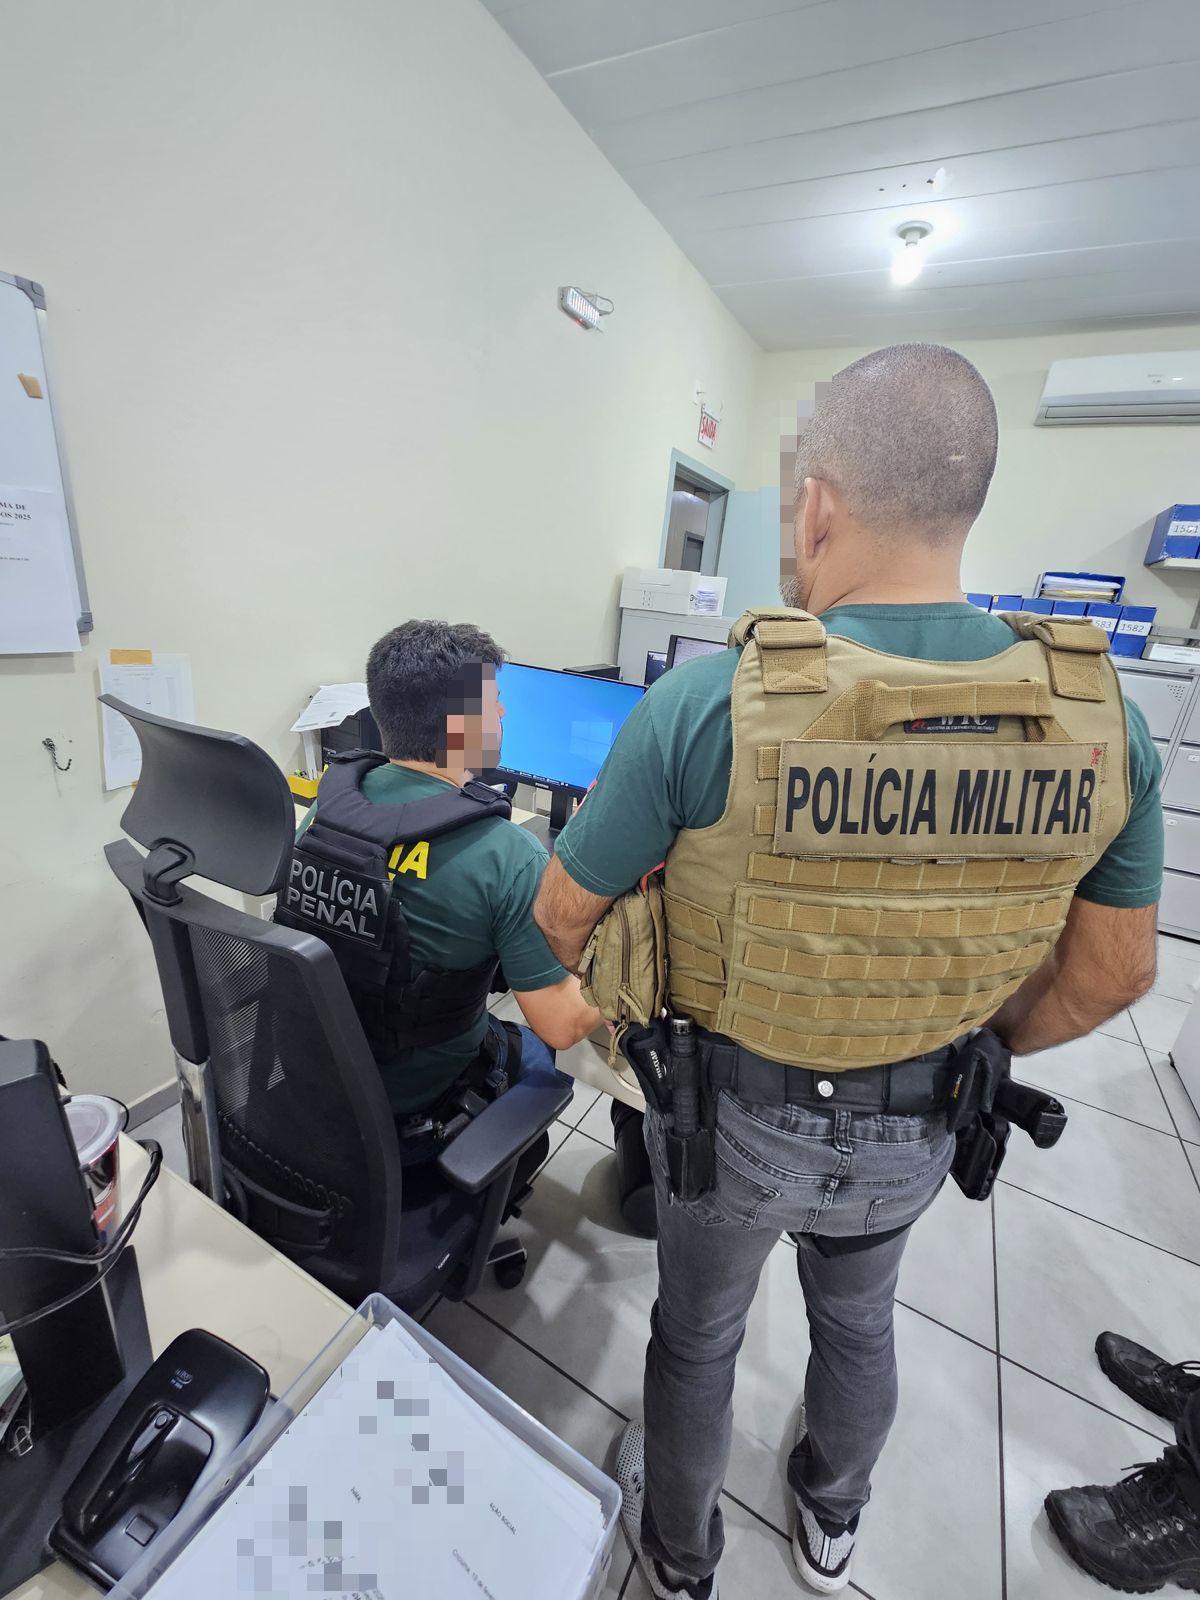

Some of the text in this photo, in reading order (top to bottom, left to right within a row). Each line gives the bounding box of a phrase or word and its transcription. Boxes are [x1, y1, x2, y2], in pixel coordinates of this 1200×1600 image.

[1121, 623, 1145, 633] 1582
[785, 753, 1096, 836] POLÍCIA MILITAR
[286, 887, 376, 939] PENAL
[289, 858, 378, 917] POLÍCIA
